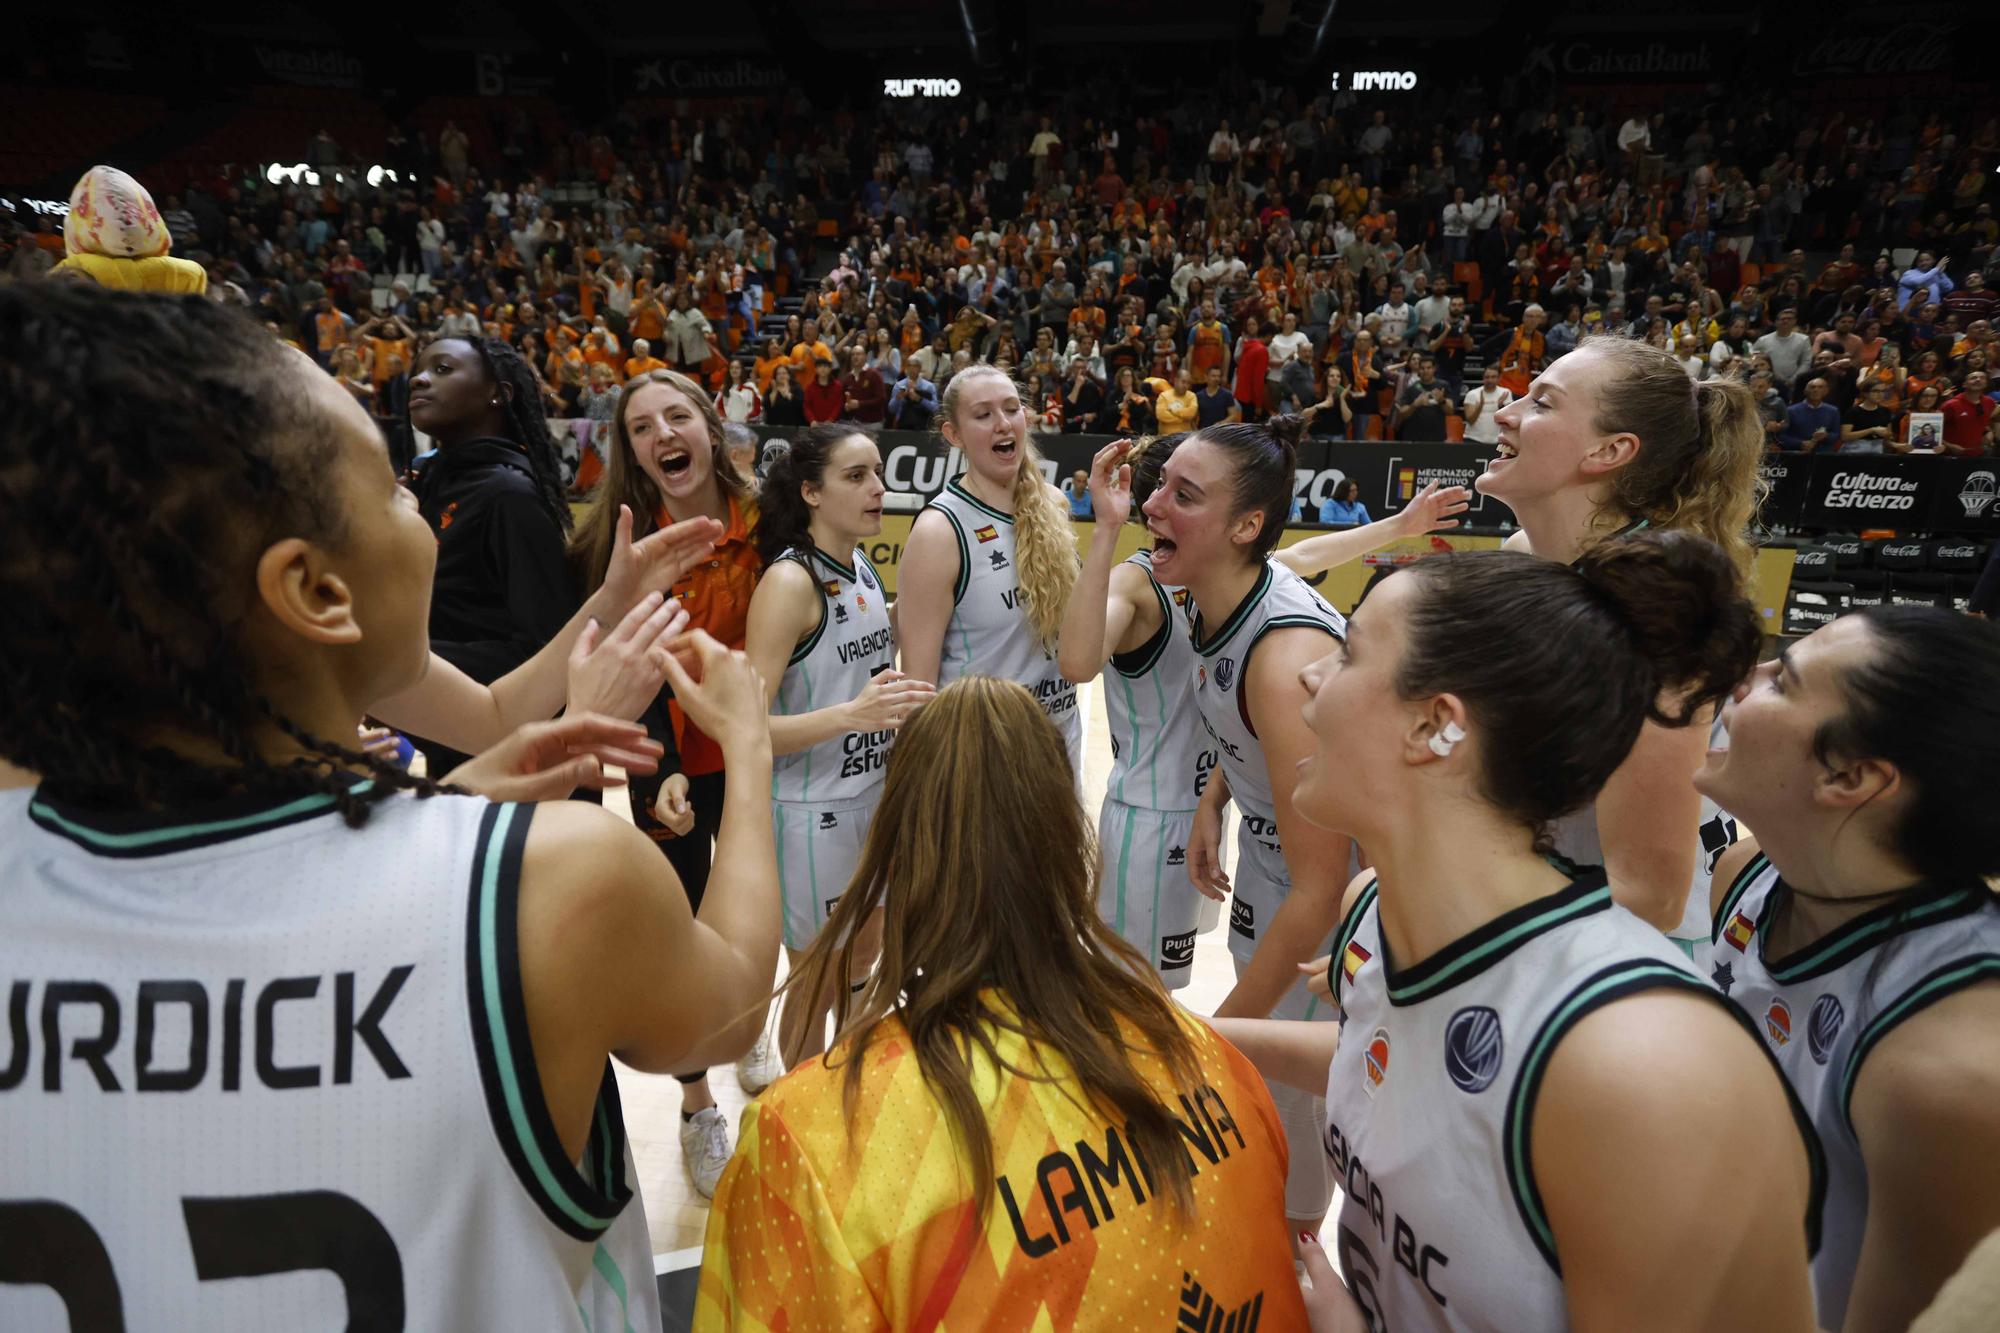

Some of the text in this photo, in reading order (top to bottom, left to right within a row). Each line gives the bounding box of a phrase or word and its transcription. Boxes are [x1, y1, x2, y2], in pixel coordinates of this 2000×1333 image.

[1561, 42, 1712, 73] CaixaBank
[669, 58, 787, 88] CaixaBank
[1332, 71, 1417, 91] mmo
[884, 79, 961, 97] zummo
[1417, 468, 1475, 477] MECENAZGO
[1831, 472, 1918, 492] Cultura del
[1824, 490, 1914, 509] Esfuerzo
[1852, 597, 1881, 606] isaval
[1804, 609, 1837, 622] isaval
[837, 627, 890, 664] VALENCIA
[1233, 901, 1251, 919] EVA
[1165, 935, 1197, 951] PULE
[1393, 1212, 1449, 1307] BC
